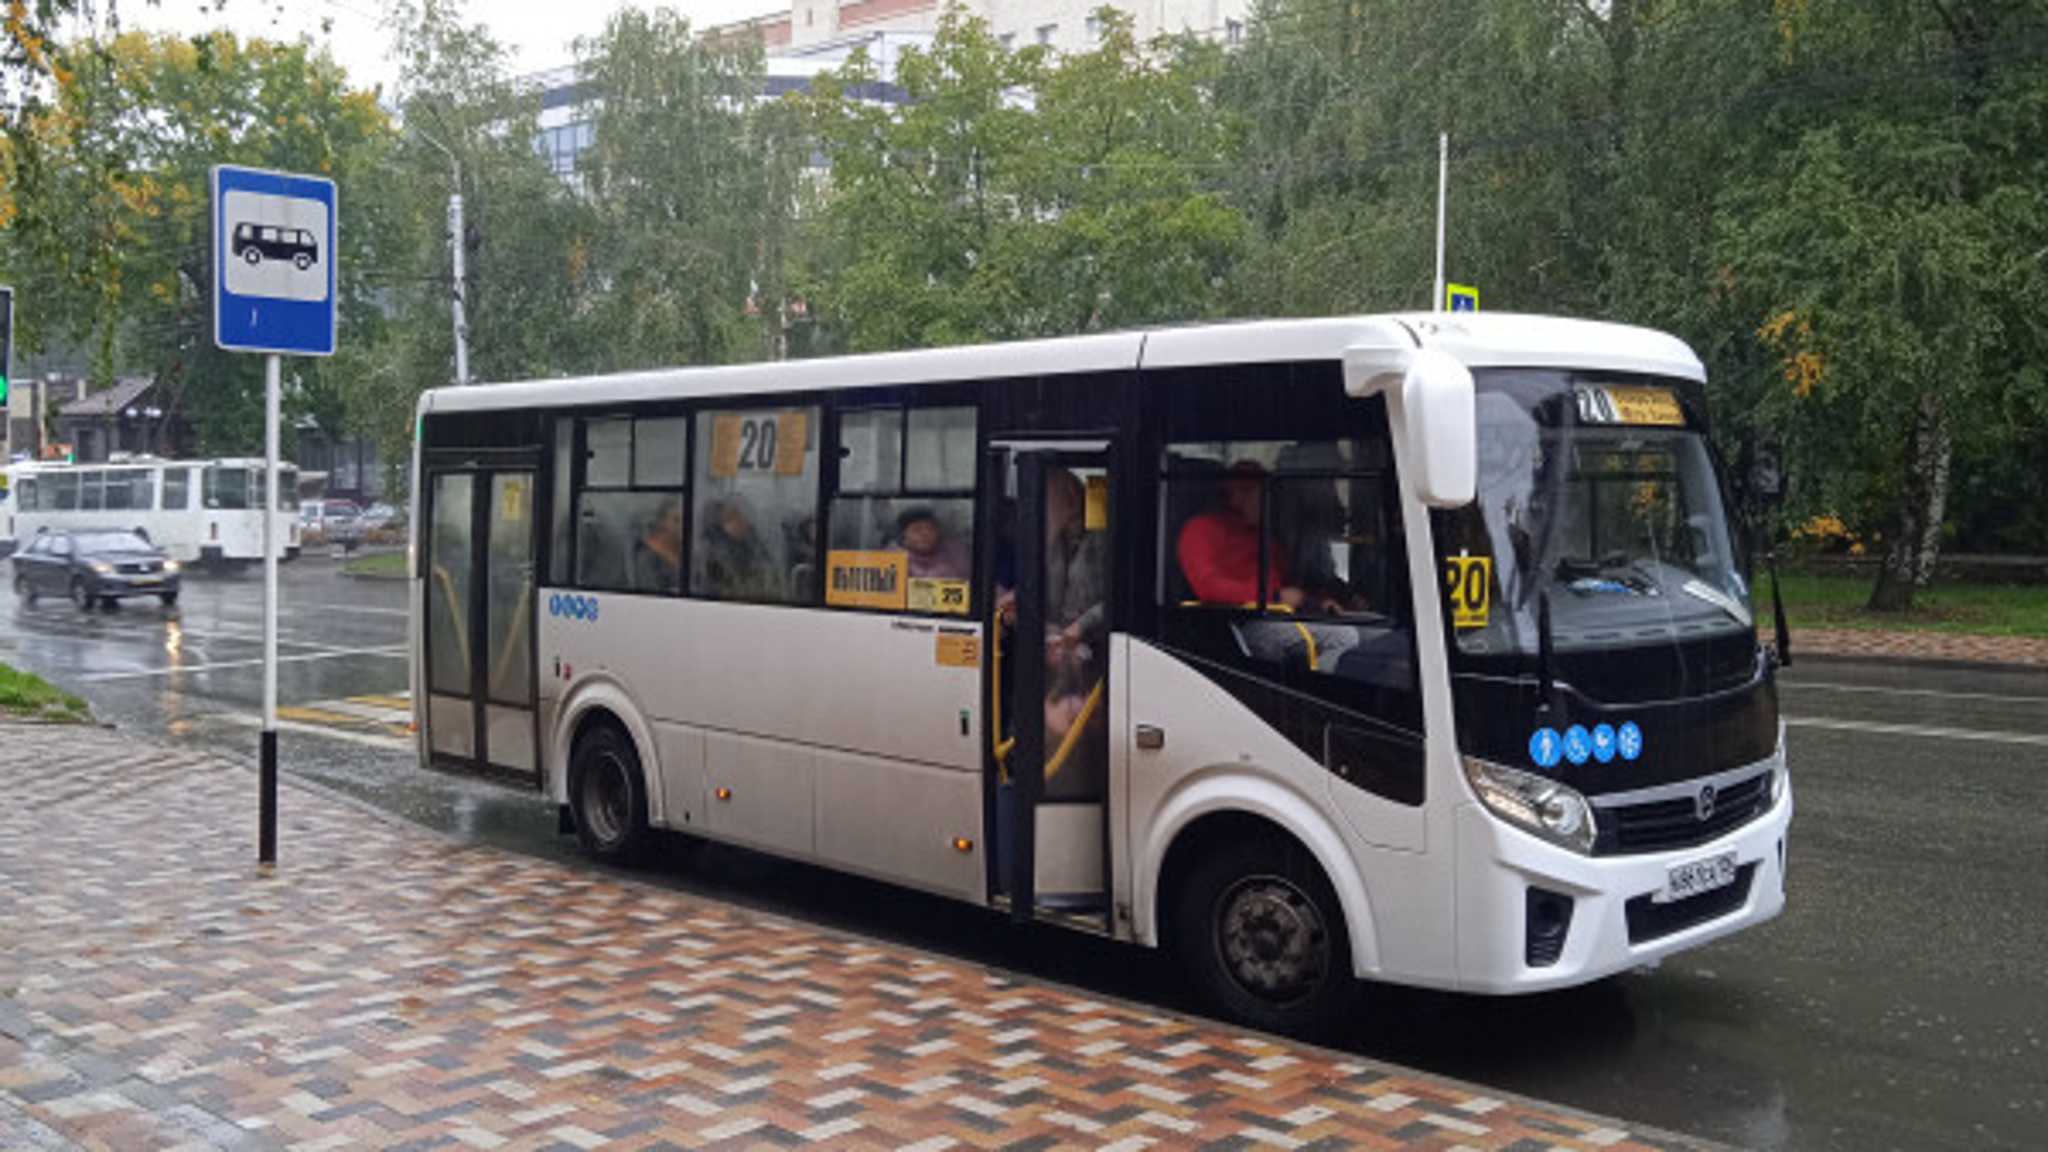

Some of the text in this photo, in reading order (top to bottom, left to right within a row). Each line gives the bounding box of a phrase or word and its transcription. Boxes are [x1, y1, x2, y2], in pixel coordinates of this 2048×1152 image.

[1577, 387, 1612, 422] 20
[738, 419, 776, 470] 20
[1445, 560, 1486, 612] 20
